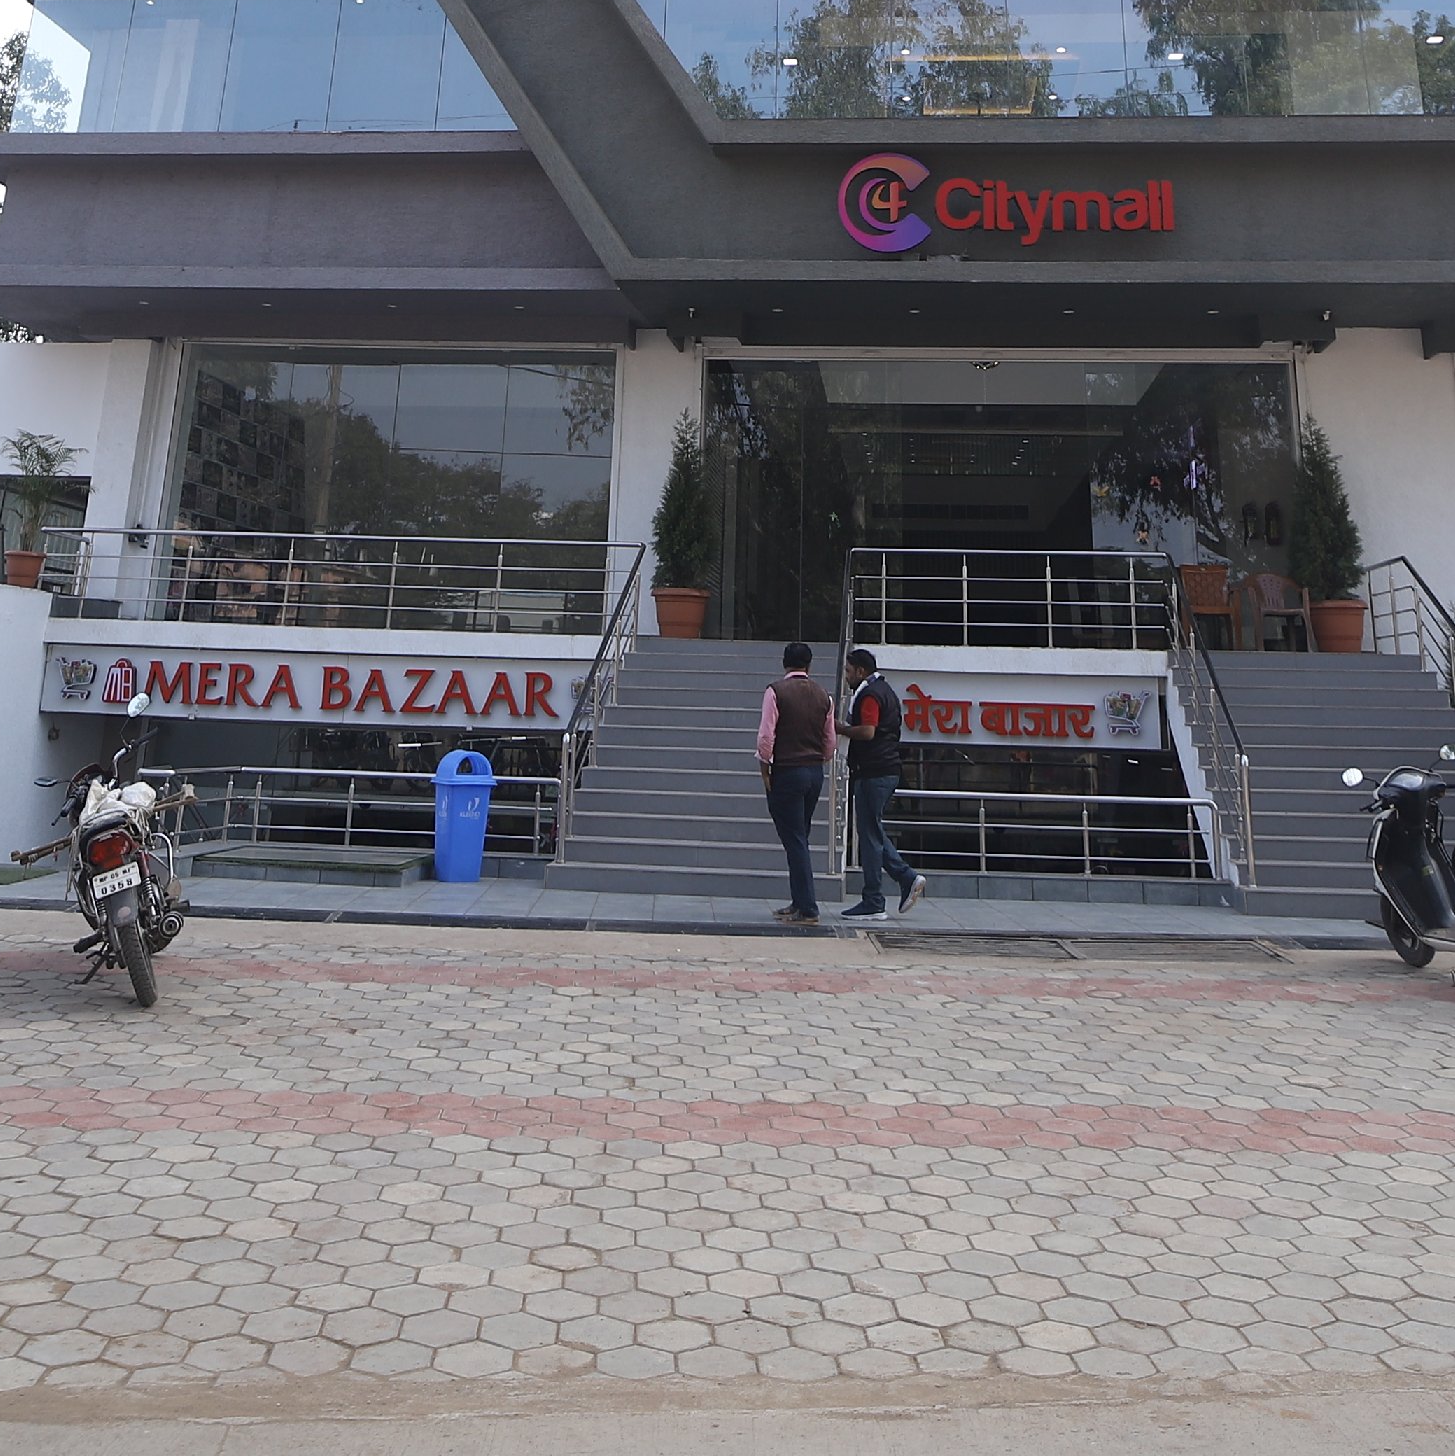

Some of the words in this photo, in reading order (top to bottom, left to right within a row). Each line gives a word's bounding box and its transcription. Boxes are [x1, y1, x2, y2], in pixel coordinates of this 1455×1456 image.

[934, 178, 1176, 246] Citymall
[144, 660, 301, 709] MERA
[320, 666, 559, 718] BAZAAR
[902, 683, 972, 734] मेरा
[979, 701, 1095, 739] बाजार
